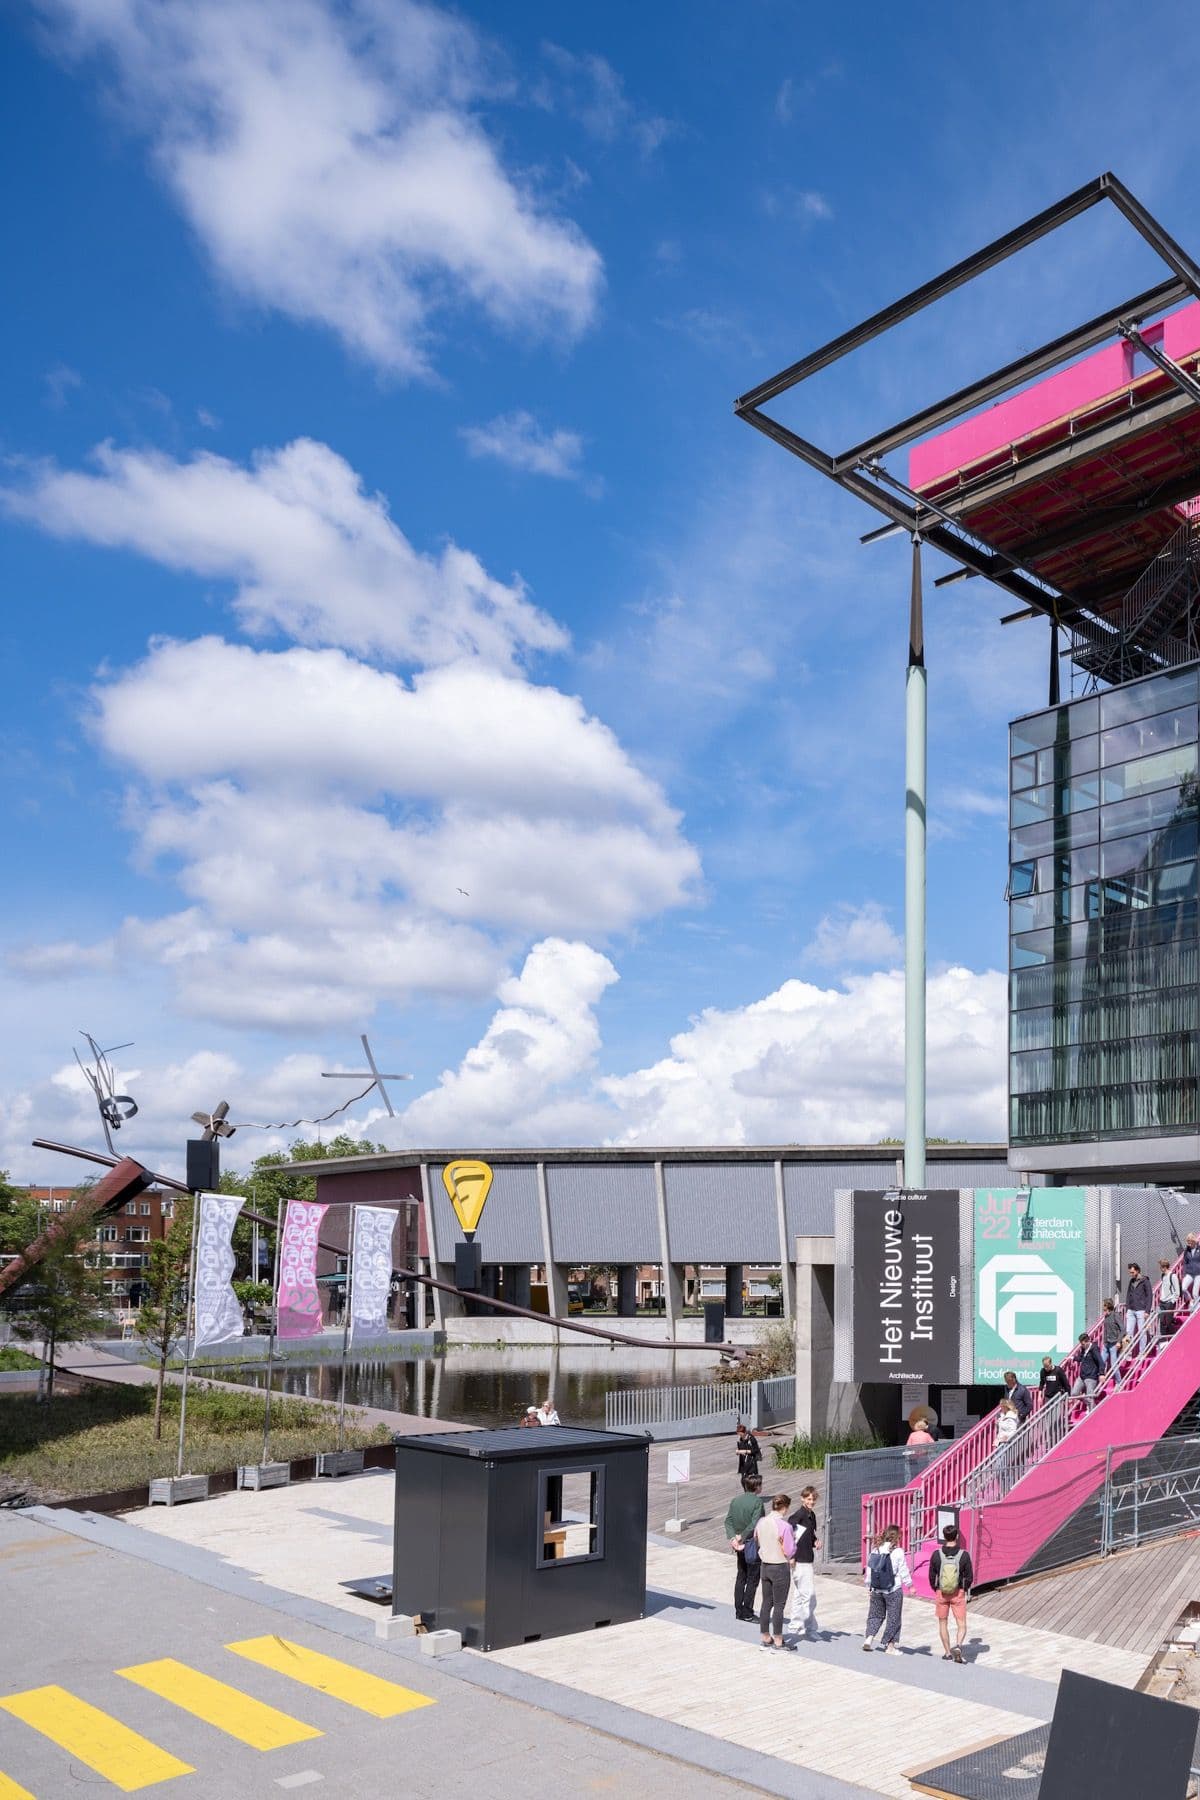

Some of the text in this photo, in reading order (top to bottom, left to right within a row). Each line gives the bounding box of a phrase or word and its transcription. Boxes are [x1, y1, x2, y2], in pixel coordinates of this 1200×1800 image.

[879, 1210, 902, 1363] Het Nieuwe
[911, 1233, 933, 1341] Instituut
[949, 1275, 957, 1298] Design
[888, 1372, 924, 1380] Architectuur
